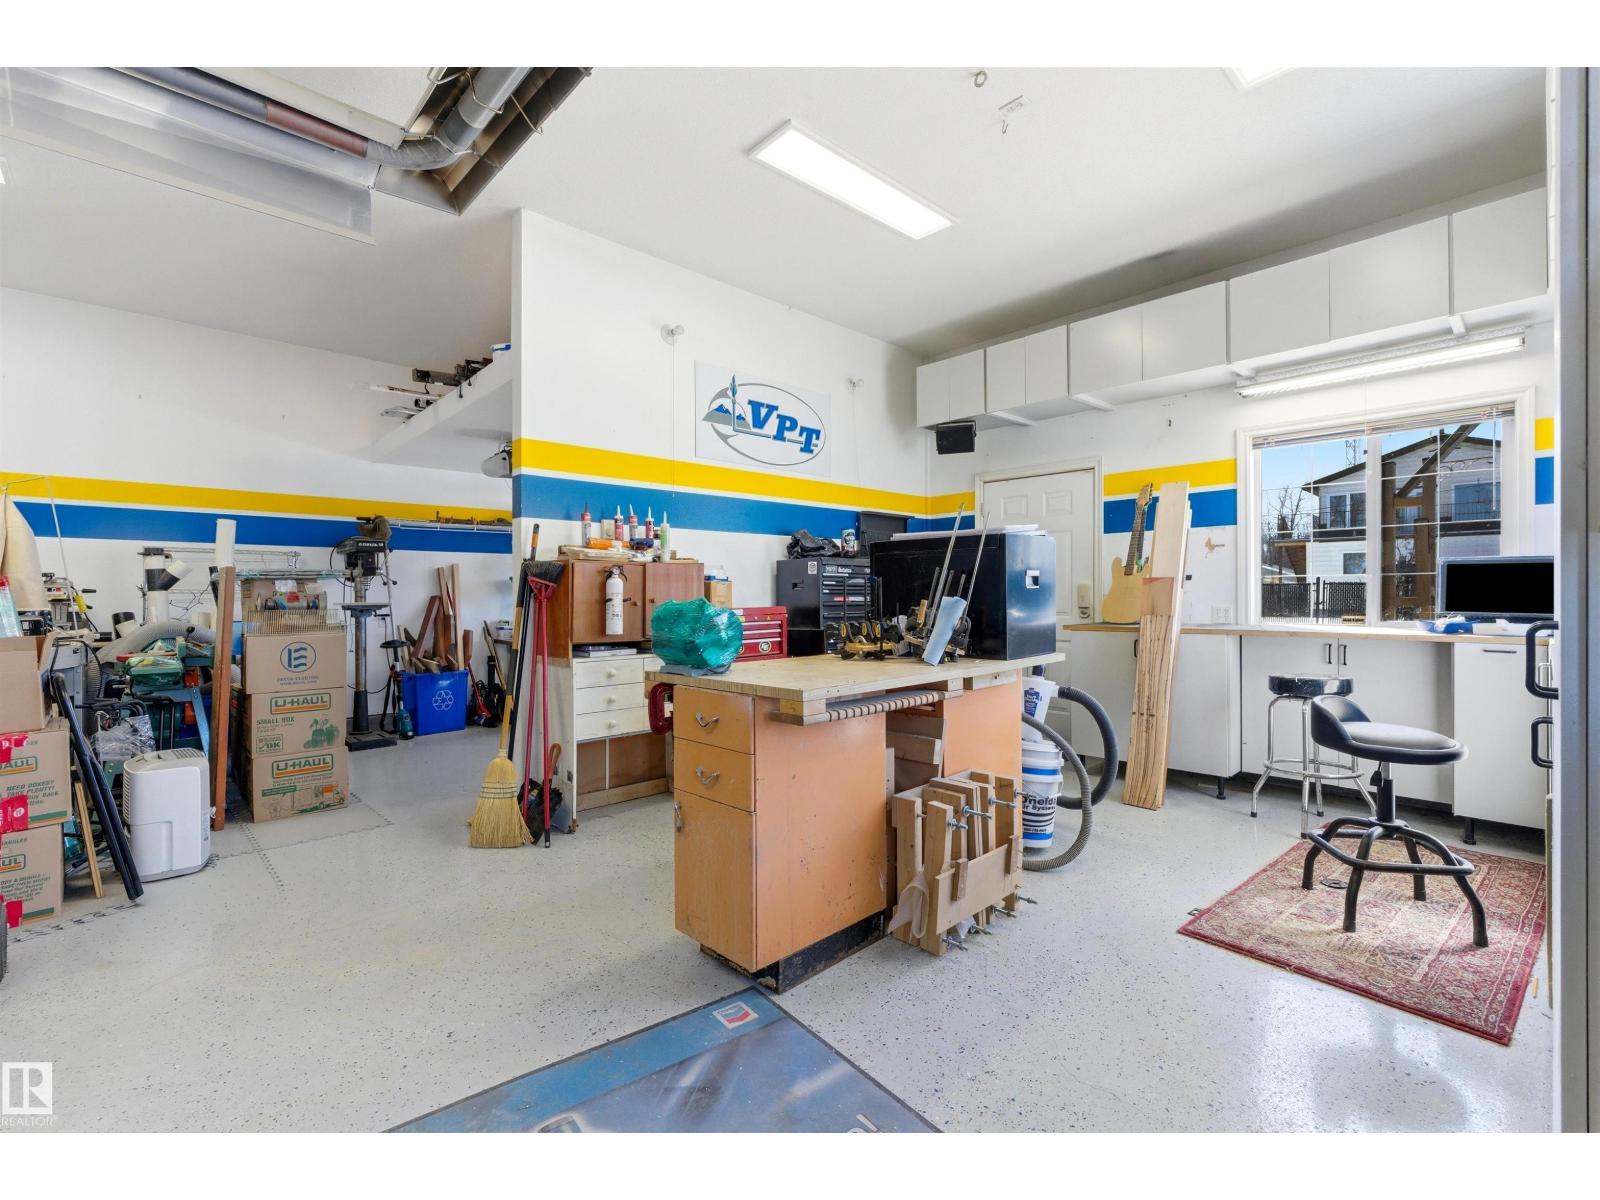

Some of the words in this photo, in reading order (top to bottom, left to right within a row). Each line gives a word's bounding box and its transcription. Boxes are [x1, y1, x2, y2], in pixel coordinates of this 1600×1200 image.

[747, 399, 821, 454] VPT
[274, 696, 328, 708] U-HAUL
[0, 761, 33, 770] AUL
[275, 757, 330, 771] U-HAUL
